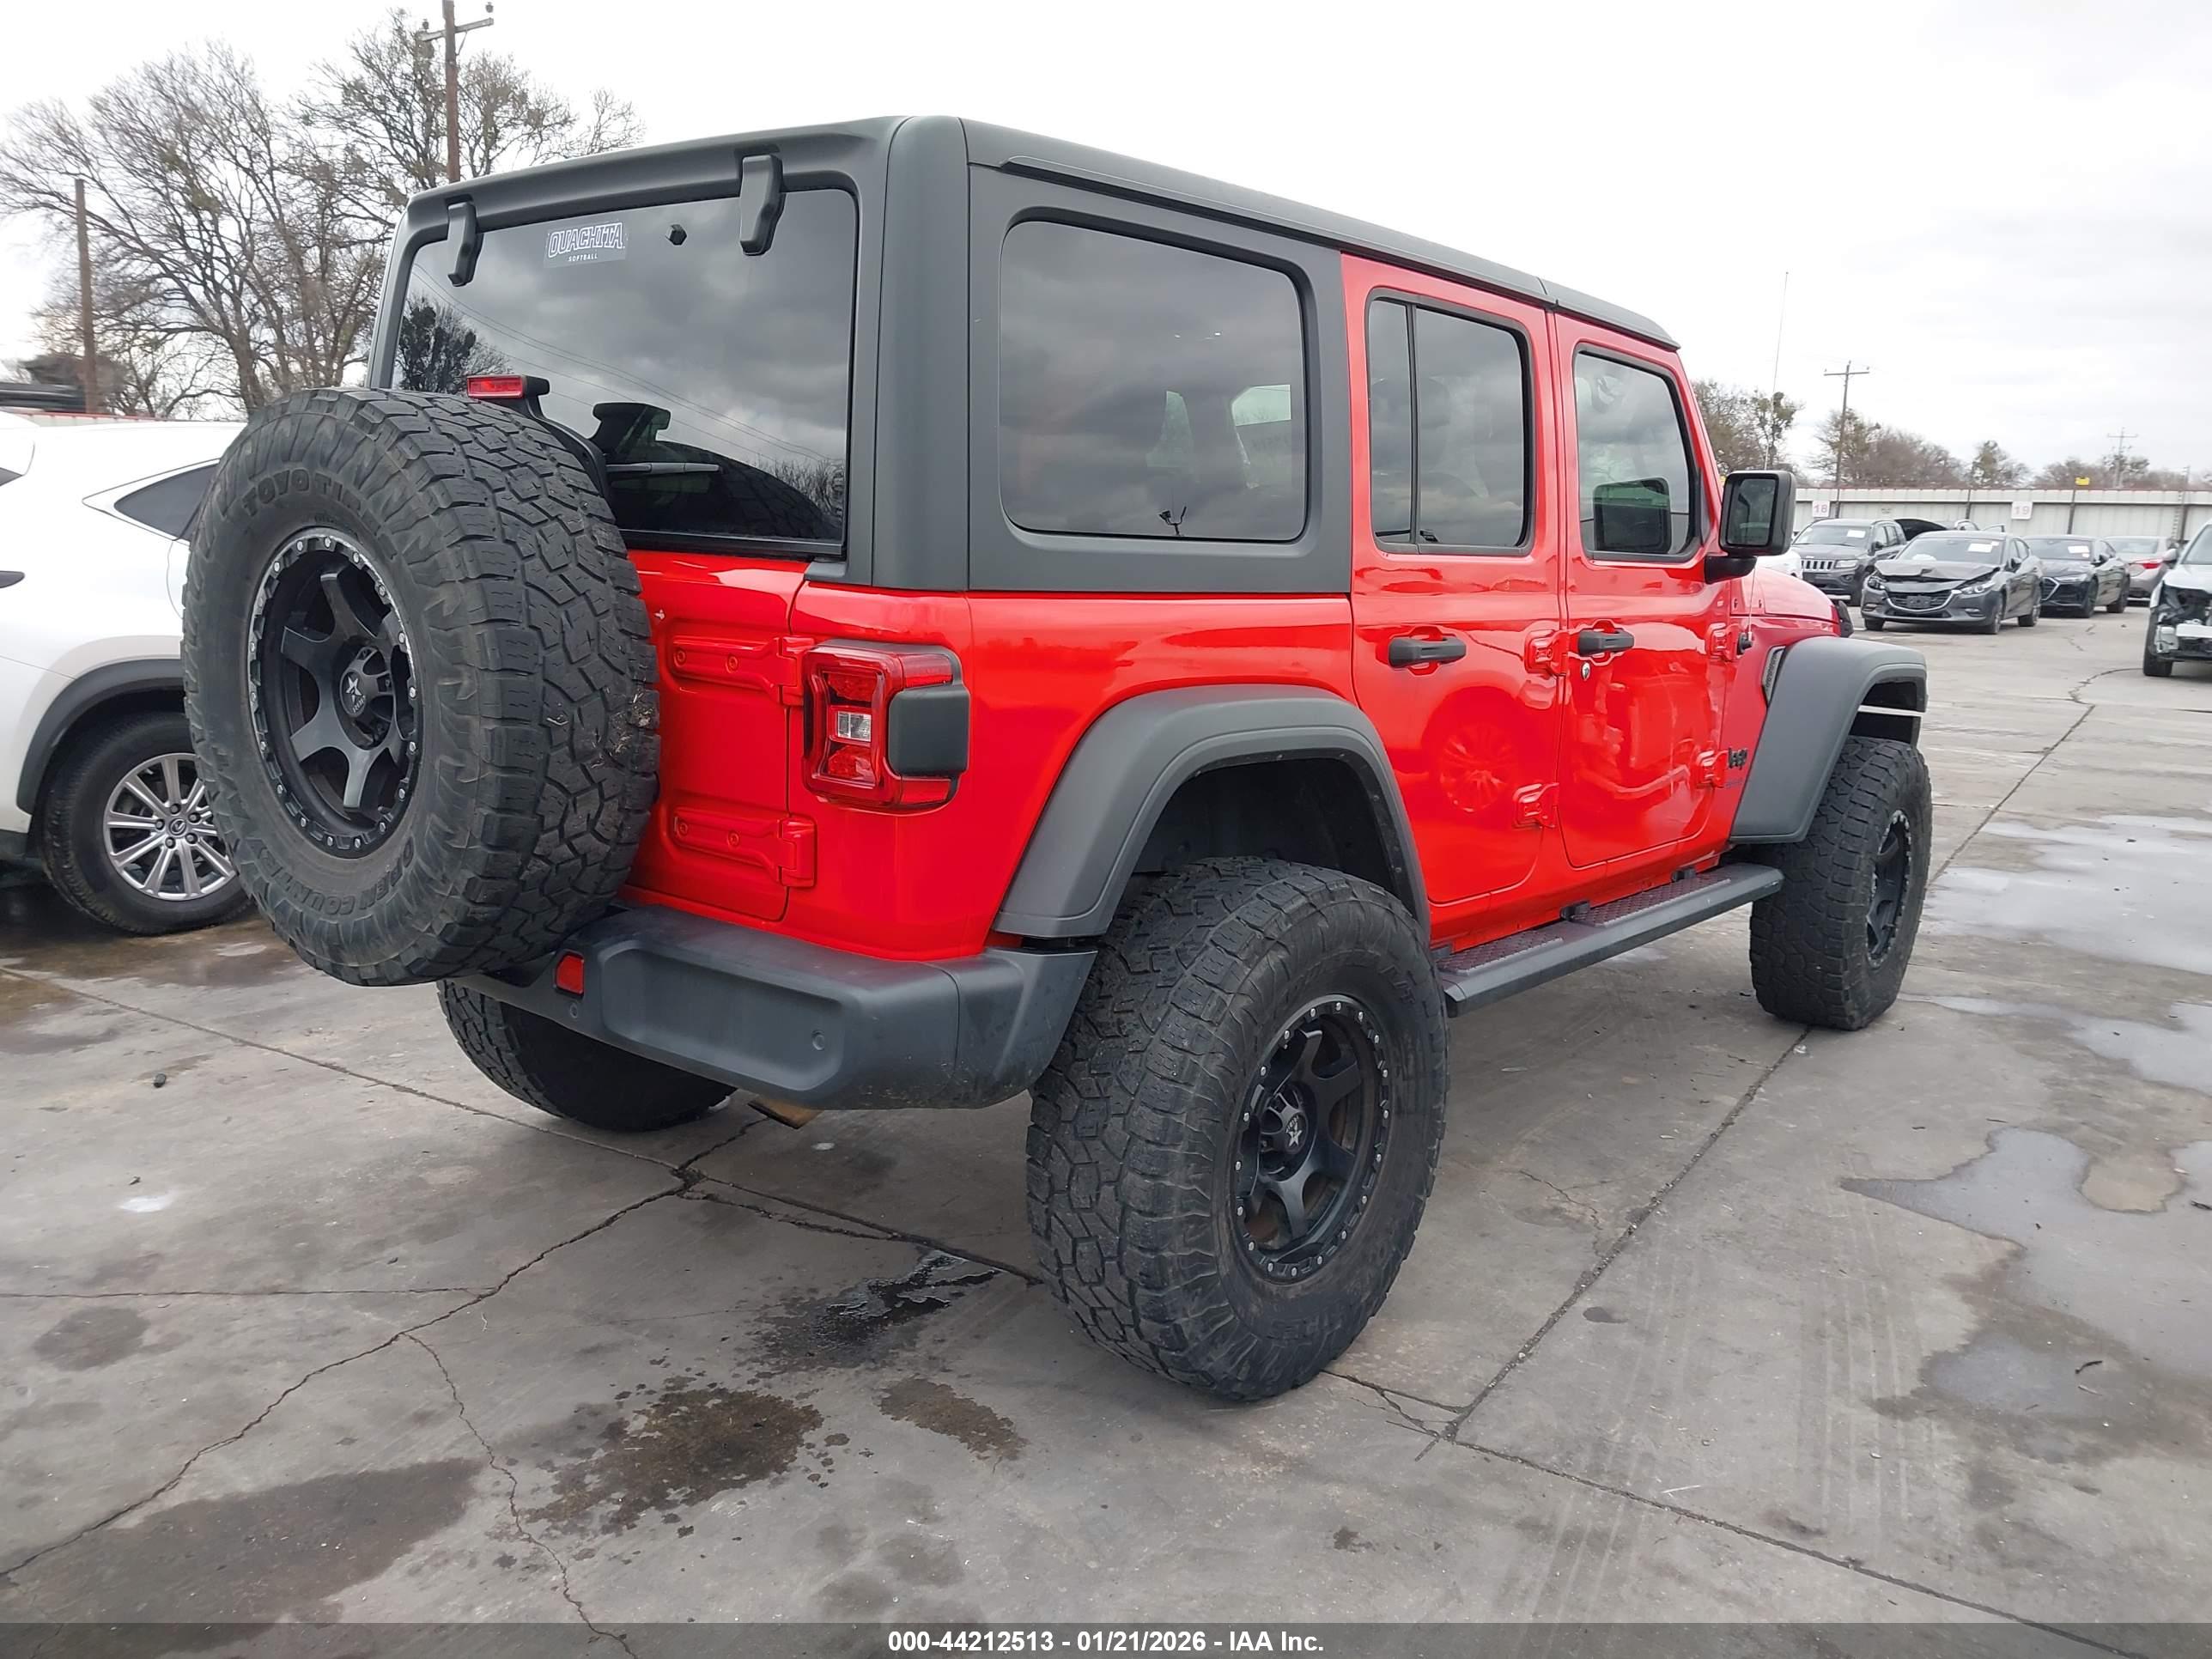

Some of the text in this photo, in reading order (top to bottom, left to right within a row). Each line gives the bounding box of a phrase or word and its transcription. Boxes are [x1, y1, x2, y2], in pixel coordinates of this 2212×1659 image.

[548, 222, 623, 258] OUACHITA
[568, 253, 598, 262] SOFTBALL
[241, 470, 310, 516] TOYO
[1814, 504, 1828, 514] 18
[2014, 505, 2031, 515] 19
[359, 836, 415, 911] OPEN
